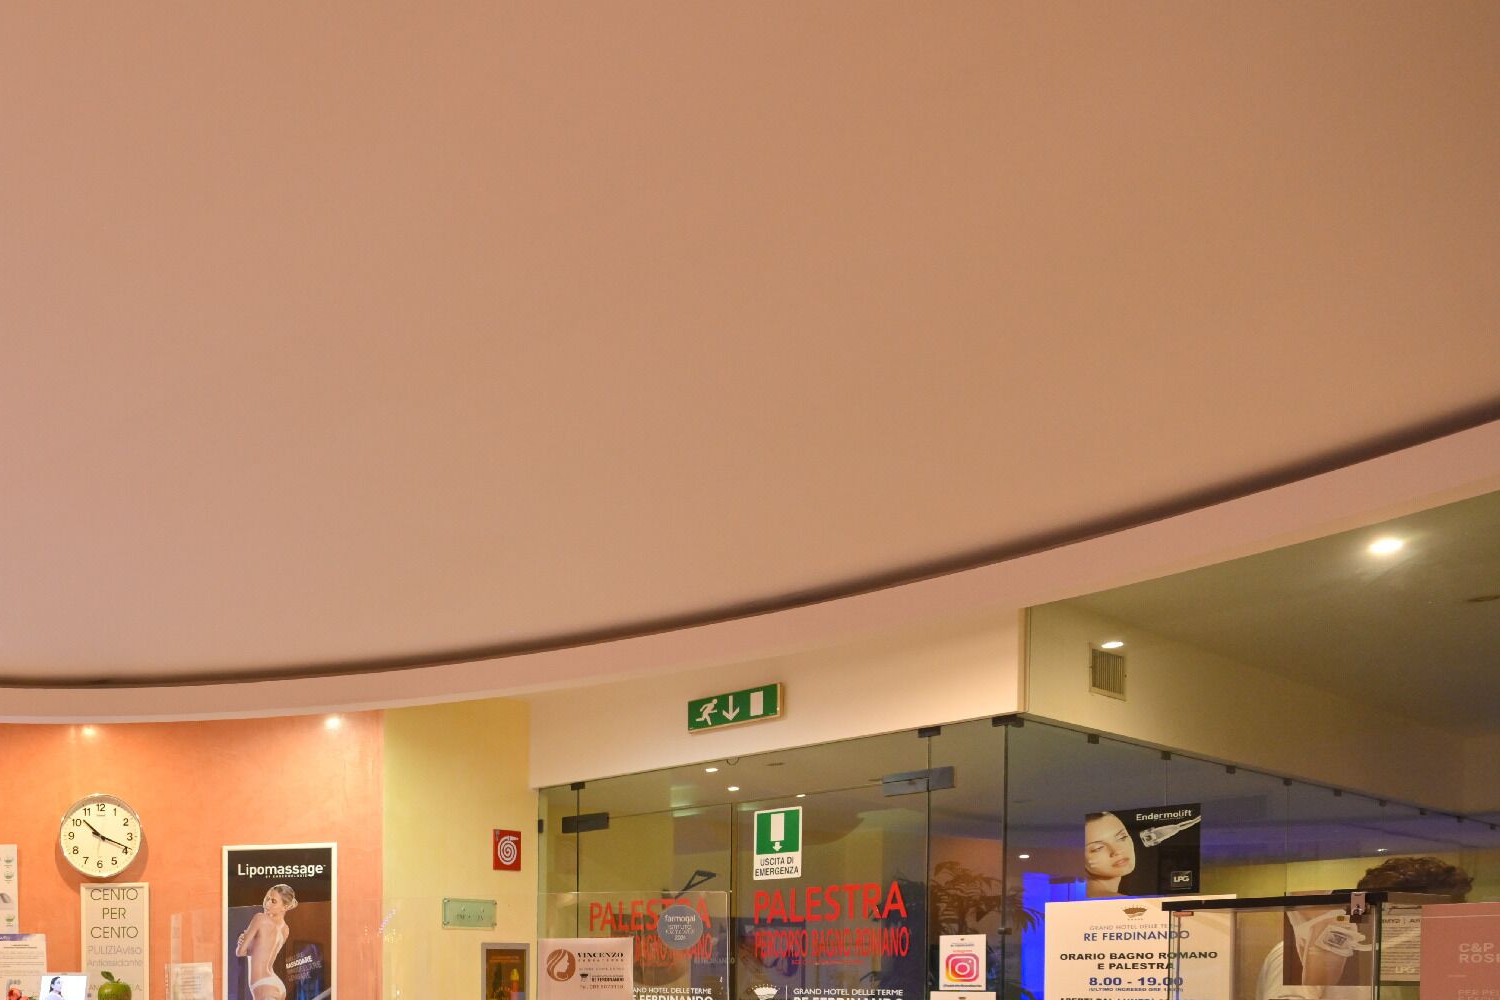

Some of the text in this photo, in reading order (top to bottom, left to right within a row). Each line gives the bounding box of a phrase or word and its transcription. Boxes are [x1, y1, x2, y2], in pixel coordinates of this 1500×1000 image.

[83, 808, 91, 816] 11
[113, 808, 117, 816] 1
[1136, 809, 1192, 821] Endermolift
[72, 819, 81, 827] 10
[123, 818, 129, 826] 2
[68, 832, 74, 840] 9
[73, 846, 79, 854] 8
[122, 847, 128, 855] 4
[97, 860, 103, 868] 6
[111, 857, 117, 865] 5
[760, 856, 794, 866] USCITA DI
[237, 863, 324, 878] Lipomassage
[755, 866, 799, 877] EMERGENZA
[1173, 875, 1190, 883] LPG
[90, 888, 138, 901] CENTO
[754, 880, 908, 925] PALESTRA
[102, 907, 127, 920] PER
[589, 896, 712, 932] PALESA
[665, 914, 696, 924] farmogal
[90, 926, 139, 939] CENTO
[1083, 930, 1190, 942] RE FERDINANDO
[755, 926, 909, 959] PERCORSO BAGNO ROMANO
[1459, 942, 1494, 953] C&P
[1059, 950, 1219, 961] ORARIO BAGNO ROMANO
[1097, 961, 1174, 970] E PALESTRA
[1088, 977, 1122, 986] 8.00
[1138, 977, 1184, 986] 19.00
[670, 987, 690, 995] DELLE
[793, 988, 822, 996] GRAND
[823, 988, 850, 996] HOTEL
[852, 988, 875, 996] DELLE
